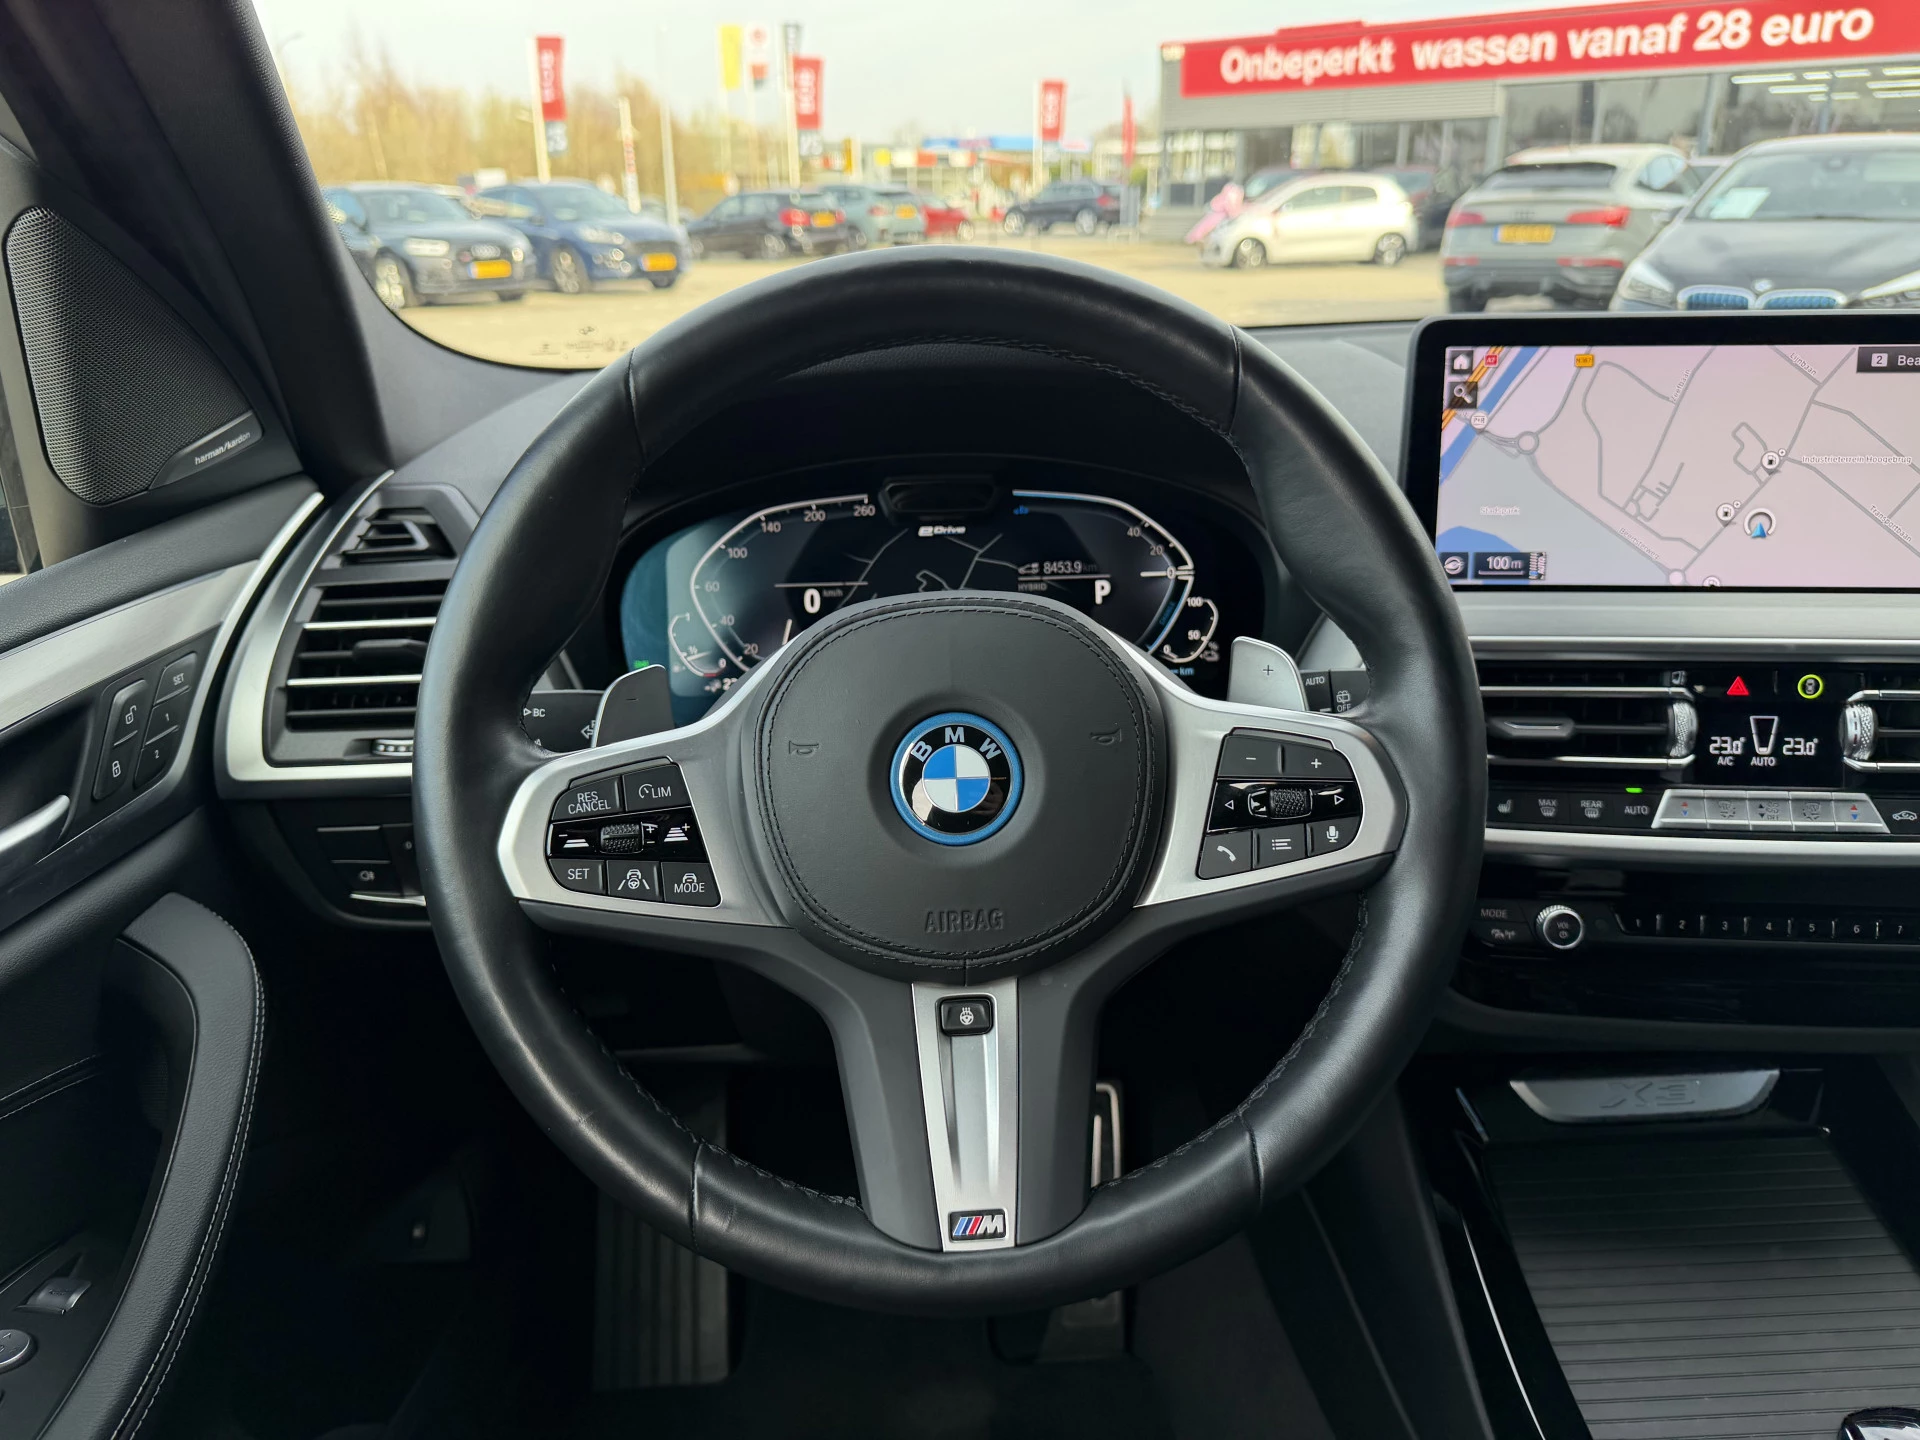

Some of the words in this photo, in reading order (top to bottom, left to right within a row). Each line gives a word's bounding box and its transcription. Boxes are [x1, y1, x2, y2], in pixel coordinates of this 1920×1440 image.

[1220, 36, 1396, 86] Onbeperkt
[1411, 30, 1557, 71] wassen
[1567, 12, 1688, 60] vanaf
[1693, 8, 1752, 52] 28
[1761, 8, 1874, 47] euro
[194, 432, 251, 465] harman/kardon
[803, 510, 826, 523] 200
[853, 505, 876, 517] 260
[761, 521, 782, 533] 140
[1127, 528, 1141, 538] 40
[727, 547, 748, 559] 100
[1150, 545, 1164, 556] 20
[1043, 561, 1082, 575] 8453.9
[705, 581, 720, 592] 60
[1094, 580, 1112, 605] P
[804, 588, 821, 614] 0
[1187, 597, 1203, 608] 100
[719, 614, 735, 626] 40
[1187, 630, 1201, 641] 50
[743, 643, 759, 655] 20
[173, 672, 185, 686] SET
[1305, 675, 1326, 686] AUTO
[532, 708, 546, 718] BC
[910, 726, 1002, 763] BMW
[1716, 756, 1735, 766] A/C
[1750, 756, 1776, 767] AUTO
[577, 791, 599, 803] RES
[652, 785, 672, 799] LIM
[568, 801, 611, 815] CANCEL
[1538, 799, 1558, 807] MAX
[1580, 800, 1602, 809] REAR
[1624, 805, 1649, 815] AUTO
[567, 868, 590, 880] SET
[674, 883, 705, 894] MODE
[1480, 908, 1508, 919] MODE
[924, 908, 1005, 934] AIRBAG
